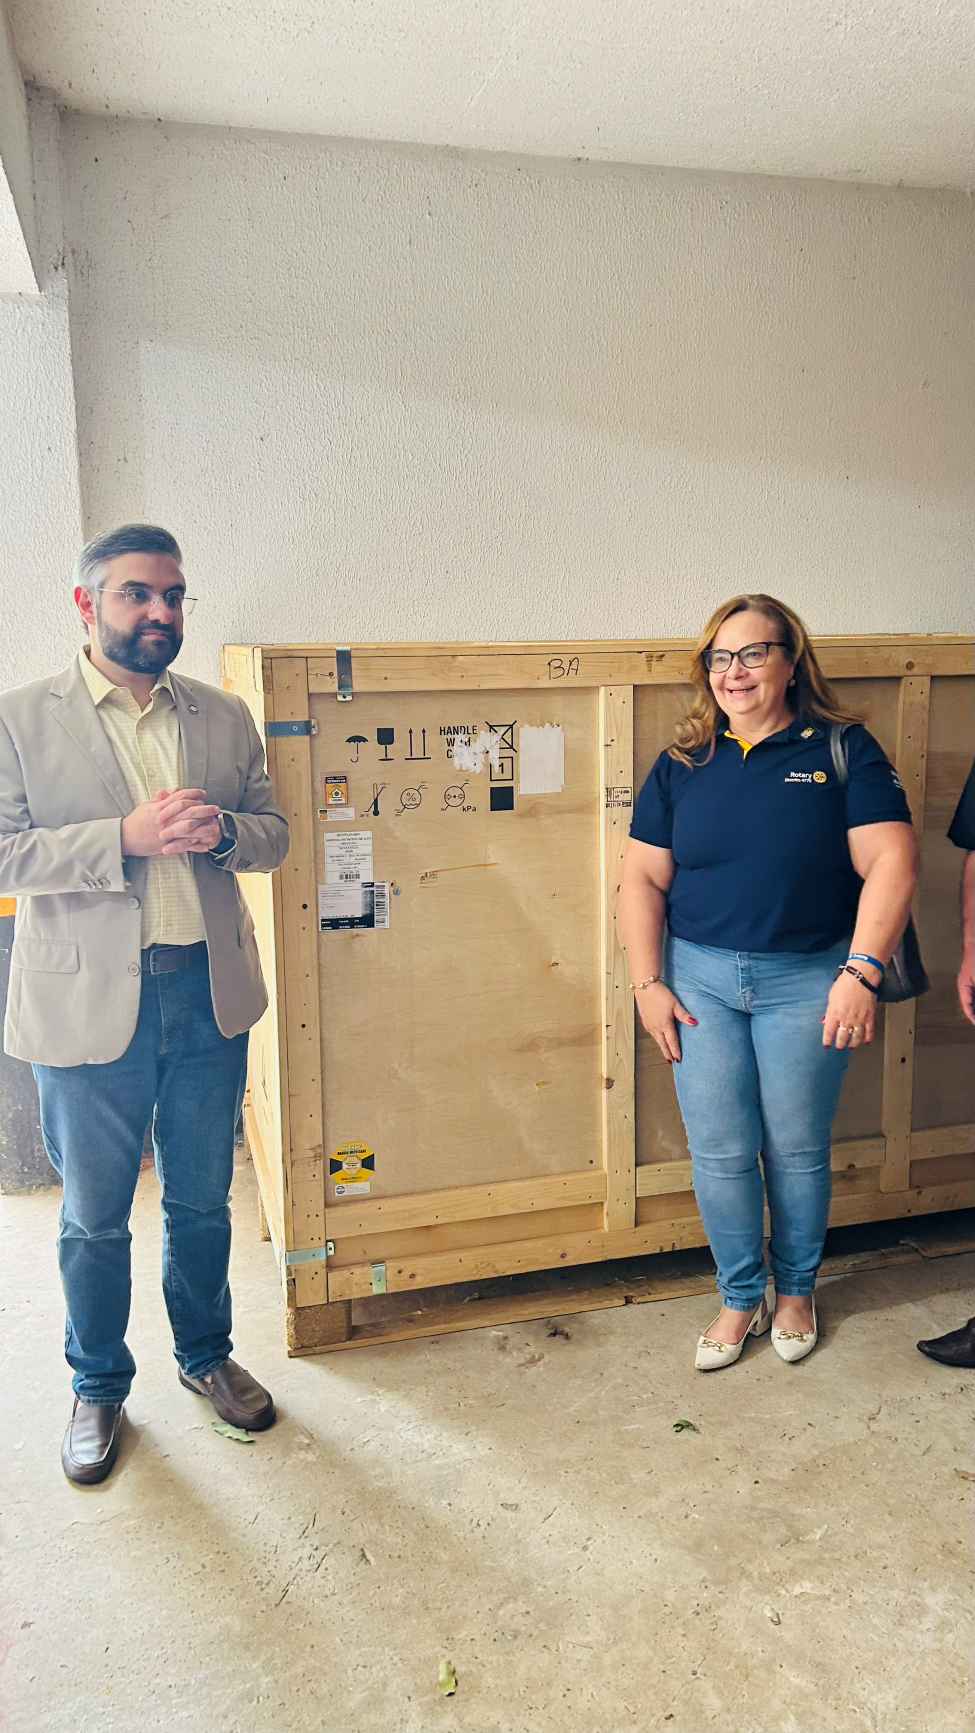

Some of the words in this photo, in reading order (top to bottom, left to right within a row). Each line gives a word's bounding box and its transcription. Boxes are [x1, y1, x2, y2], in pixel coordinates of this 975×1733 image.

[547, 656, 580, 680] BA
[439, 725, 478, 736] HANDLE
[498, 762, 504, 774] 1
[790, 771, 813, 779] Rotary
[462, 805, 477, 813] kPa
